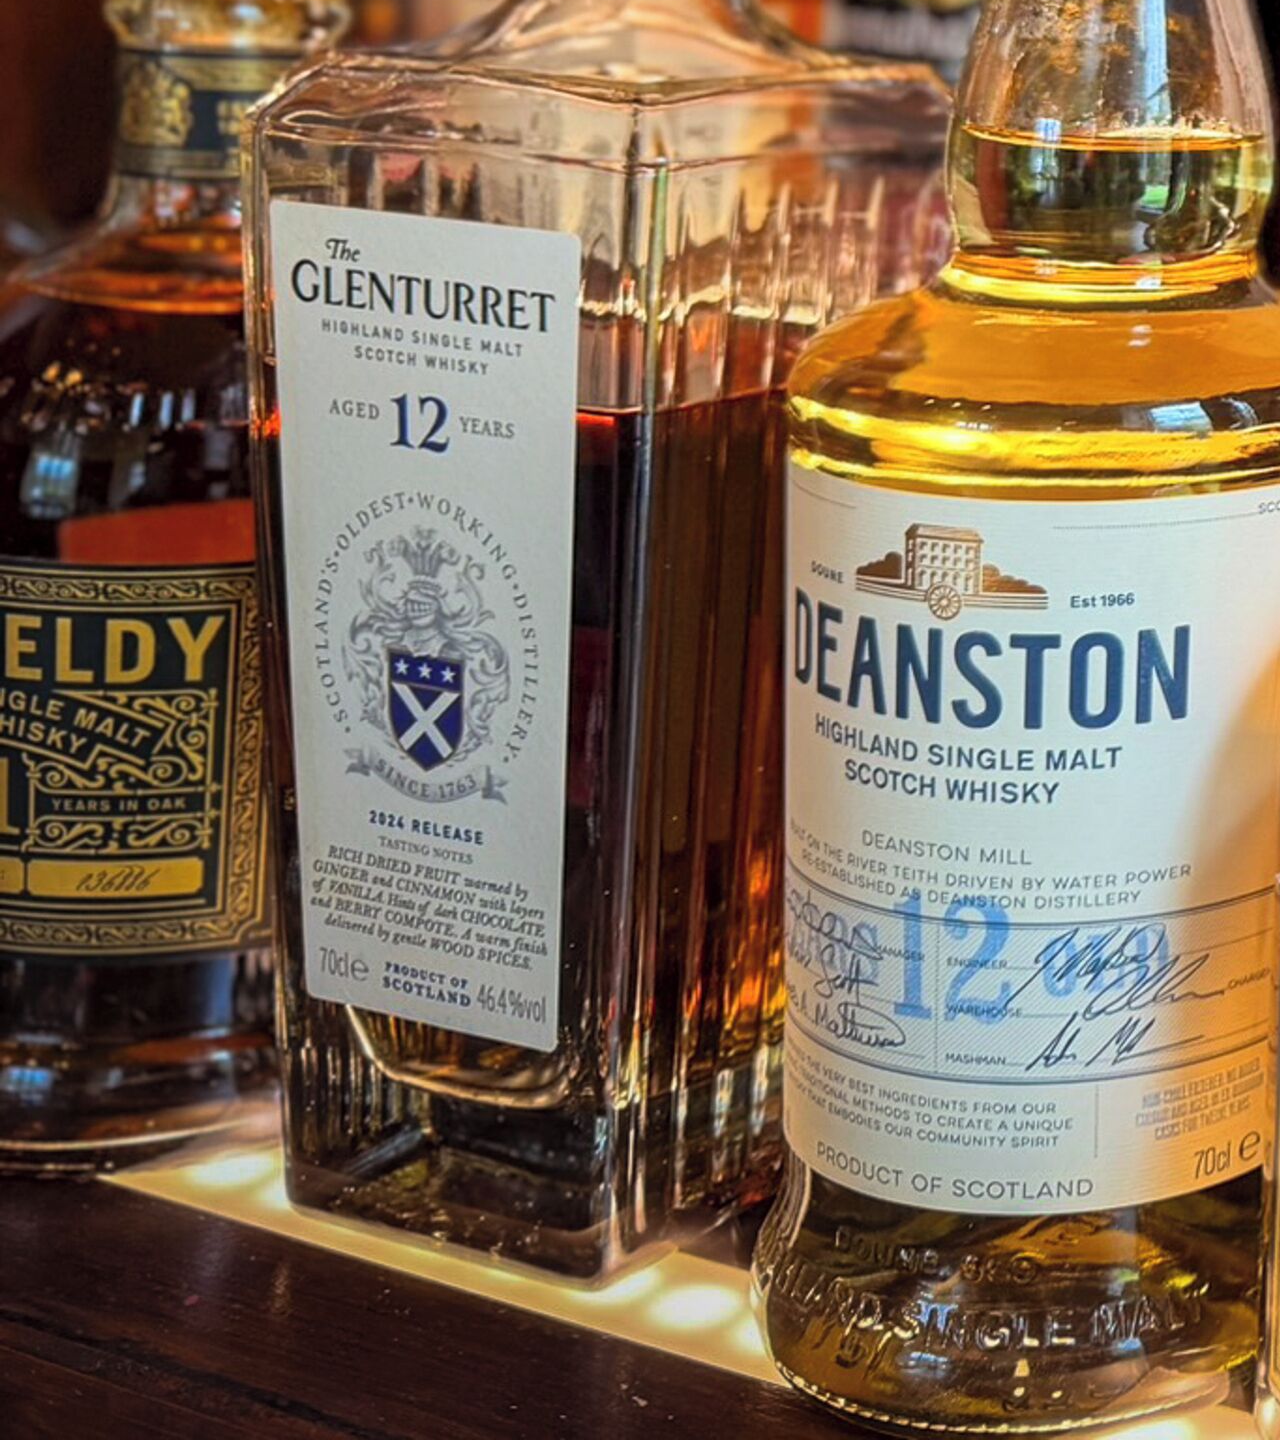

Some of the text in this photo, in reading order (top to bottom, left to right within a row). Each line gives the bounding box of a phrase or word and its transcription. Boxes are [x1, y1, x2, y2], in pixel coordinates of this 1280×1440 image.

[324, 238, 361, 262] The
[291, 259, 556, 333] GLENTURRET
[321, 318, 524, 358] HIGHLAND SINGLE MALT
[354, 345, 490, 376] SCOTCH WHISKY
[329, 393, 516, 454] AGED 12 YEARS
[811, 560, 845, 586] DOUNE
[1069, 591, 1136, 610] Est 1966
[4, 613, 227, 684] ELDY
[793, 585, 1192, 731] DEANSTON
[73, 707, 153, 748] MALT
[814, 711, 1123, 773] HIGHLAND SINGLE MALT
[374, 758, 478, 800] SINCE 1763
[843, 758, 1061, 807] SCOTCH WHISKY
[52, 796, 188, 813] YEARS IN OAK
[369, 809, 485, 846] 2024 RELEASE
[378, 835, 475, 866] TASTING NOTES
[823, 842, 1193, 891] THE RIVER TEITH DRIVEN BY WATER POWER
[861, 829, 1033, 867] DEANSTON MILL
[312, 859, 546, 921] GINGER CINNAMON with layers
[328, 844, 530, 903] RICH DRIED FRUIT warmed by
[899, 885, 922, 902] AS
[927, 889, 1027, 910] DEANSTON
[1033, 890, 1143, 910] DISTILLERY
[324, 913, 376, 937] delivered
[391, 928, 428, 950] gentle
[430, 936, 476, 960] WOOD
[334, 897, 549, 958] BERRY COMPOTE. warm finish
[460, 908, 546, 939] CHOCOLATE
[384, 961, 471, 991] PRODUCT OF
[893, 888, 1013, 1026] 12
[382, 976, 473, 1009] SCOTLAND
[851, 1097, 1074, 1131] METHODS TO CREATE UNIQUE
[877, 1086, 1057, 1115] INGREDIENTS FROM OUR
[916, 1128, 1061, 1148] COMMUNITY SPIRIT
[816, 1140, 1094, 1200] PRODUCT OF SCOTLAND
[1193, 1140, 1232, 1180] 70cl
